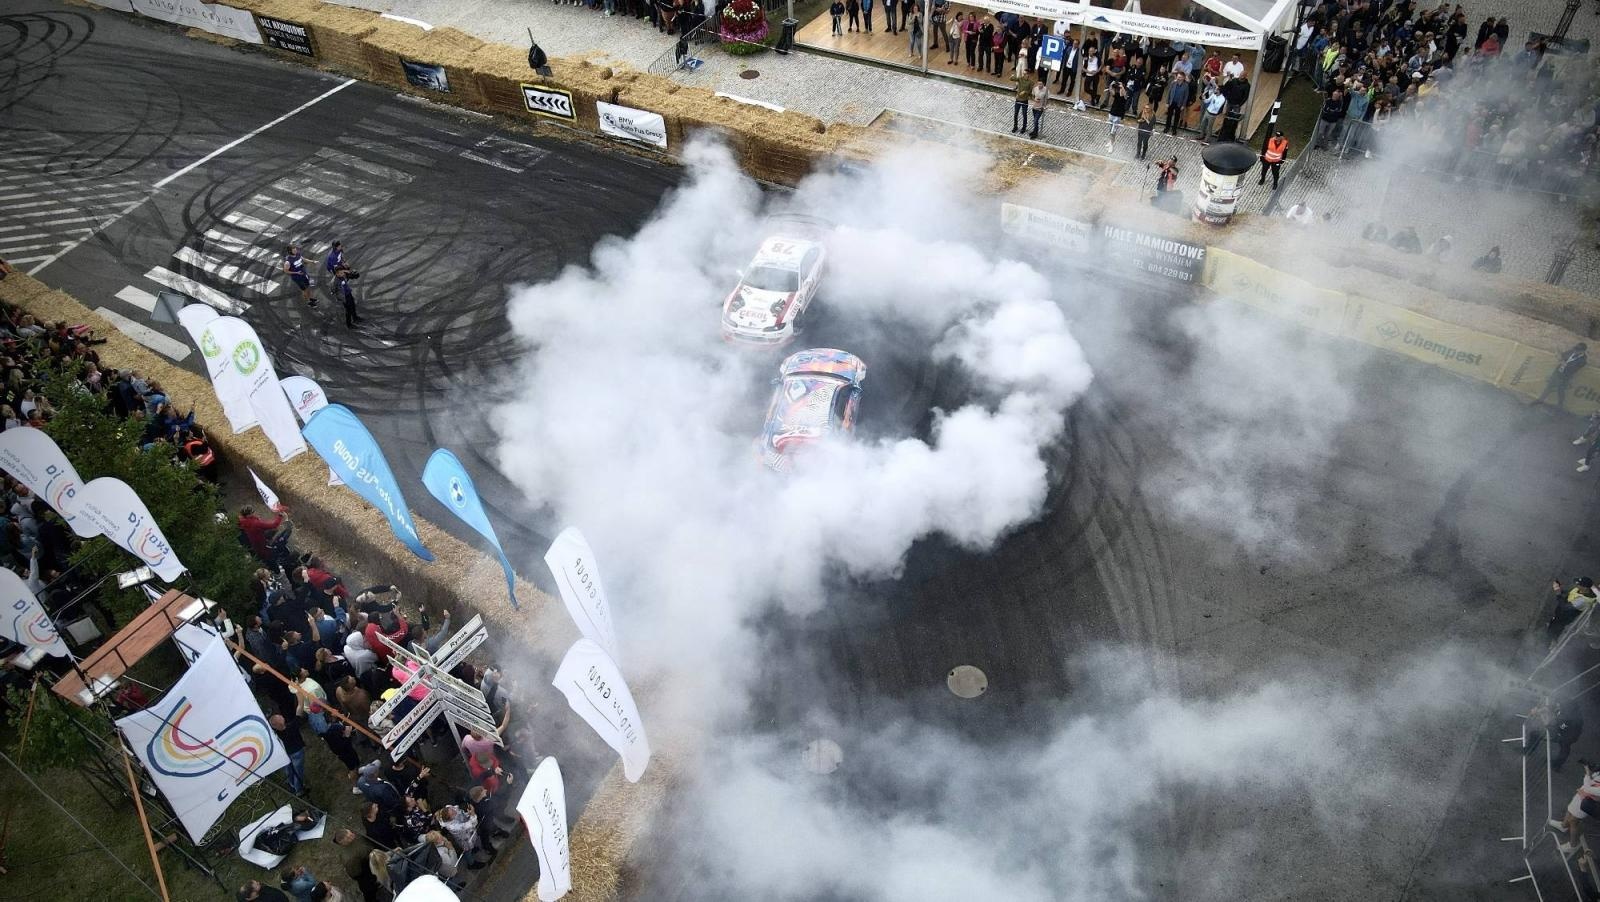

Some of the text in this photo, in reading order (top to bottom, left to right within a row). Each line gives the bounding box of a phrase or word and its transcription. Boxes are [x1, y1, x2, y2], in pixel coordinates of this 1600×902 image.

[1046, 38, 1060, 56] P
[618, 116, 634, 126] BMW
[1135, 233, 1206, 261] NAMIOTOWE
[1403, 330, 1483, 366] Chempest
